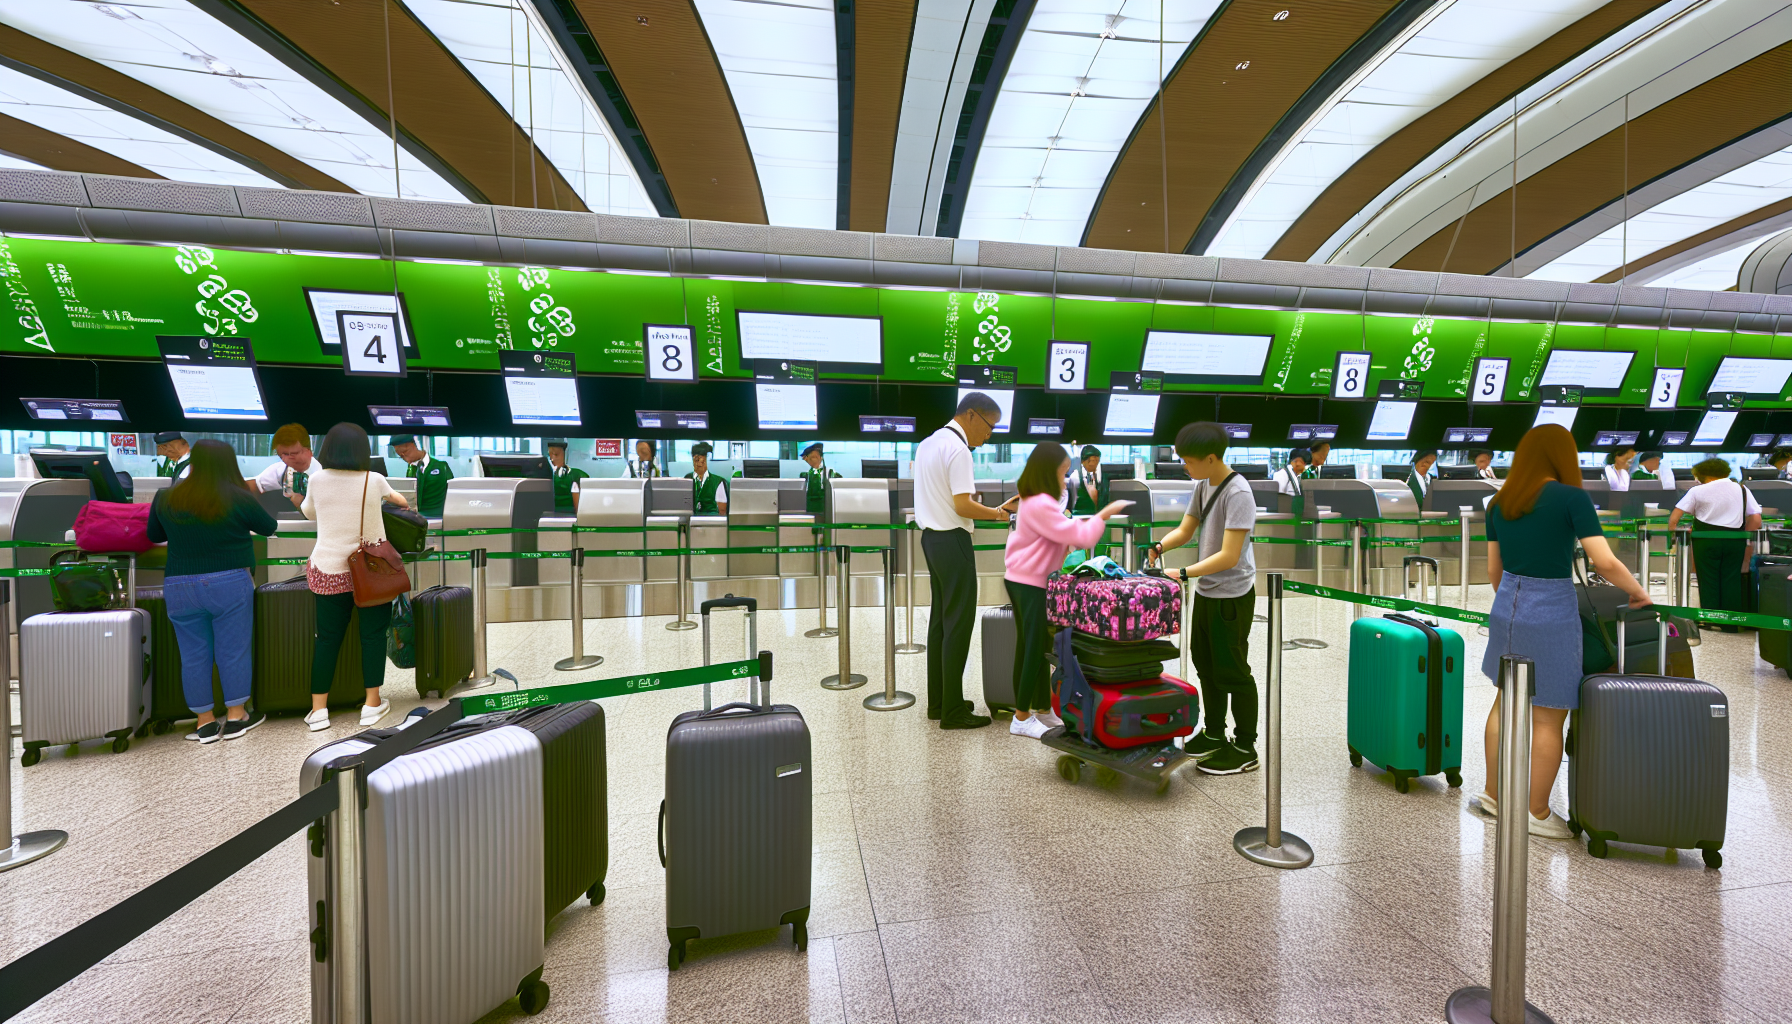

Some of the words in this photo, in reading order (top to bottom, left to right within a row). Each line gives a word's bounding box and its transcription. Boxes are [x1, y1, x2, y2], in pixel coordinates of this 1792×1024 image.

[364, 335, 387, 363] 4
[662, 345, 682, 372] 8
[1059, 358, 1075, 383] 3
[1344, 369, 1359, 391] 8
